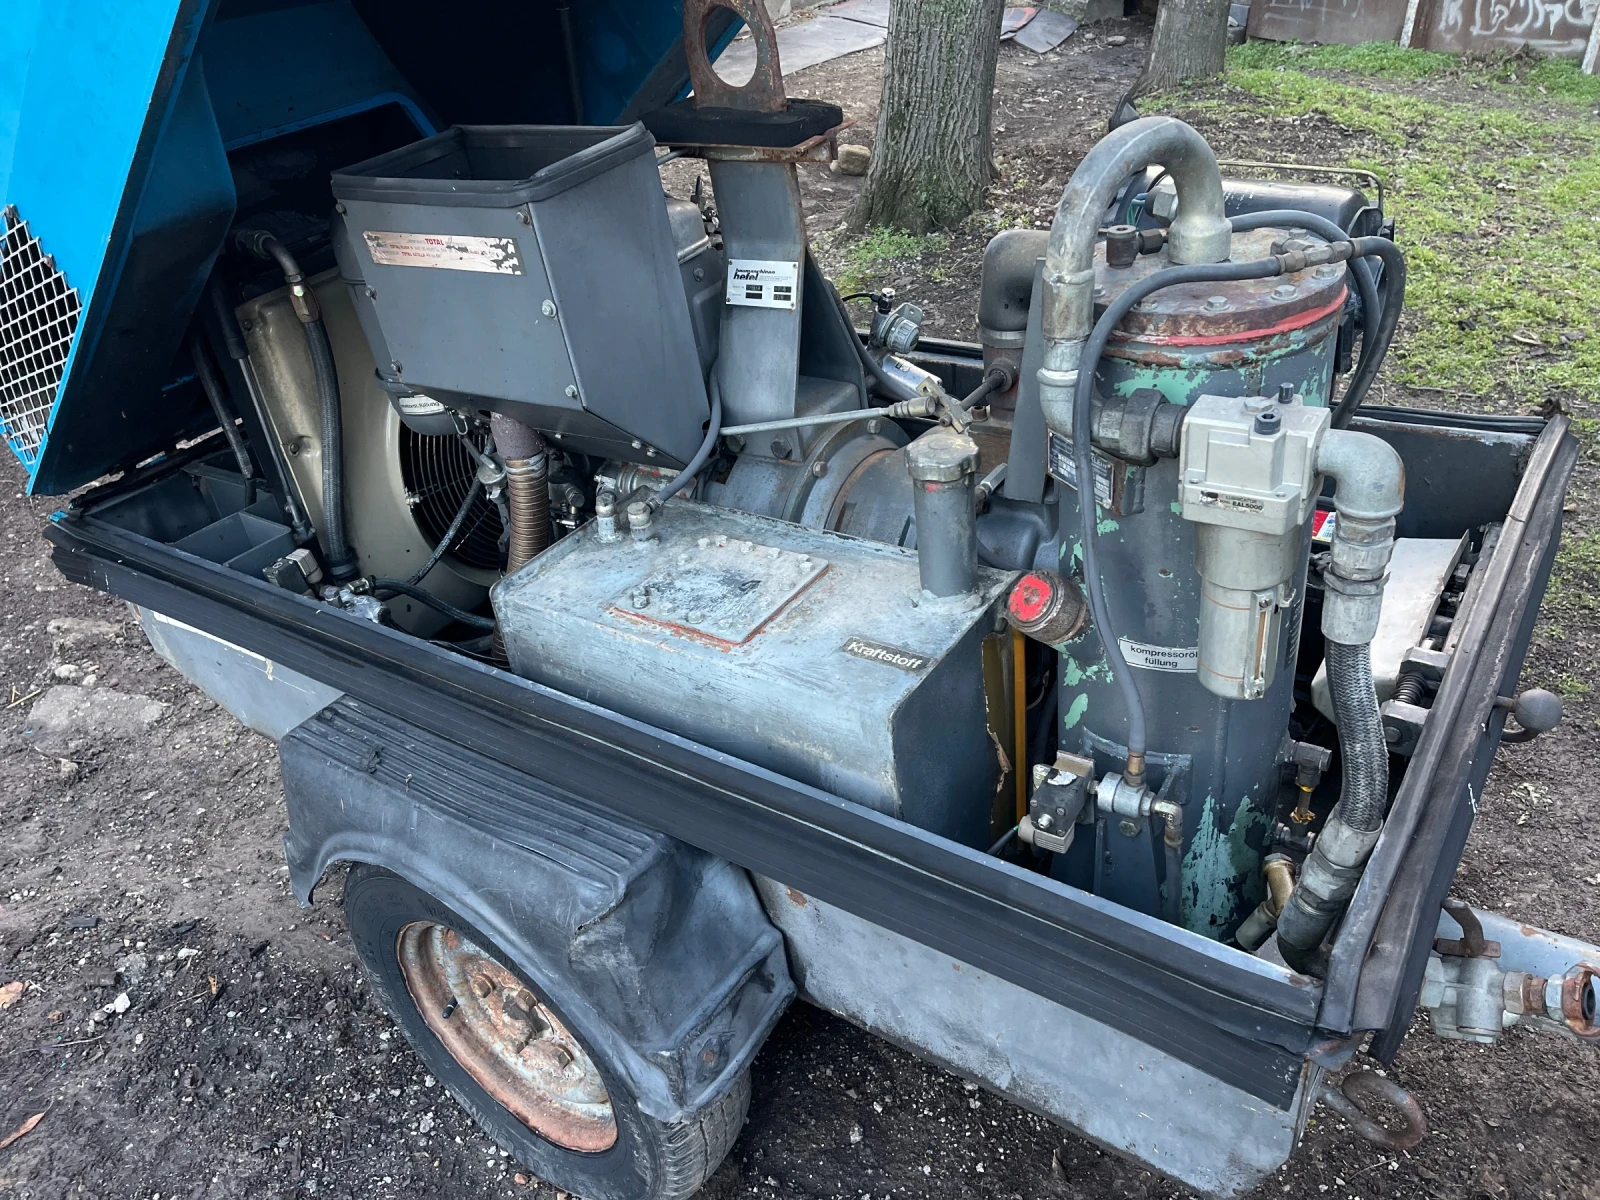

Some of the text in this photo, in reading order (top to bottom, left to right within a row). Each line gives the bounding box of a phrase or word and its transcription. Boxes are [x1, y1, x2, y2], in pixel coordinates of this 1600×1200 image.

[425, 238, 445, 246] TOTAL
[733, 272, 758, 280] hefel
[1232, 501, 1263, 511] EAL5000
[847, 641, 923, 669] Kraftstoff
[1130, 645, 1198, 658] kompressoröl
[1144, 657, 1178, 668] füllung
